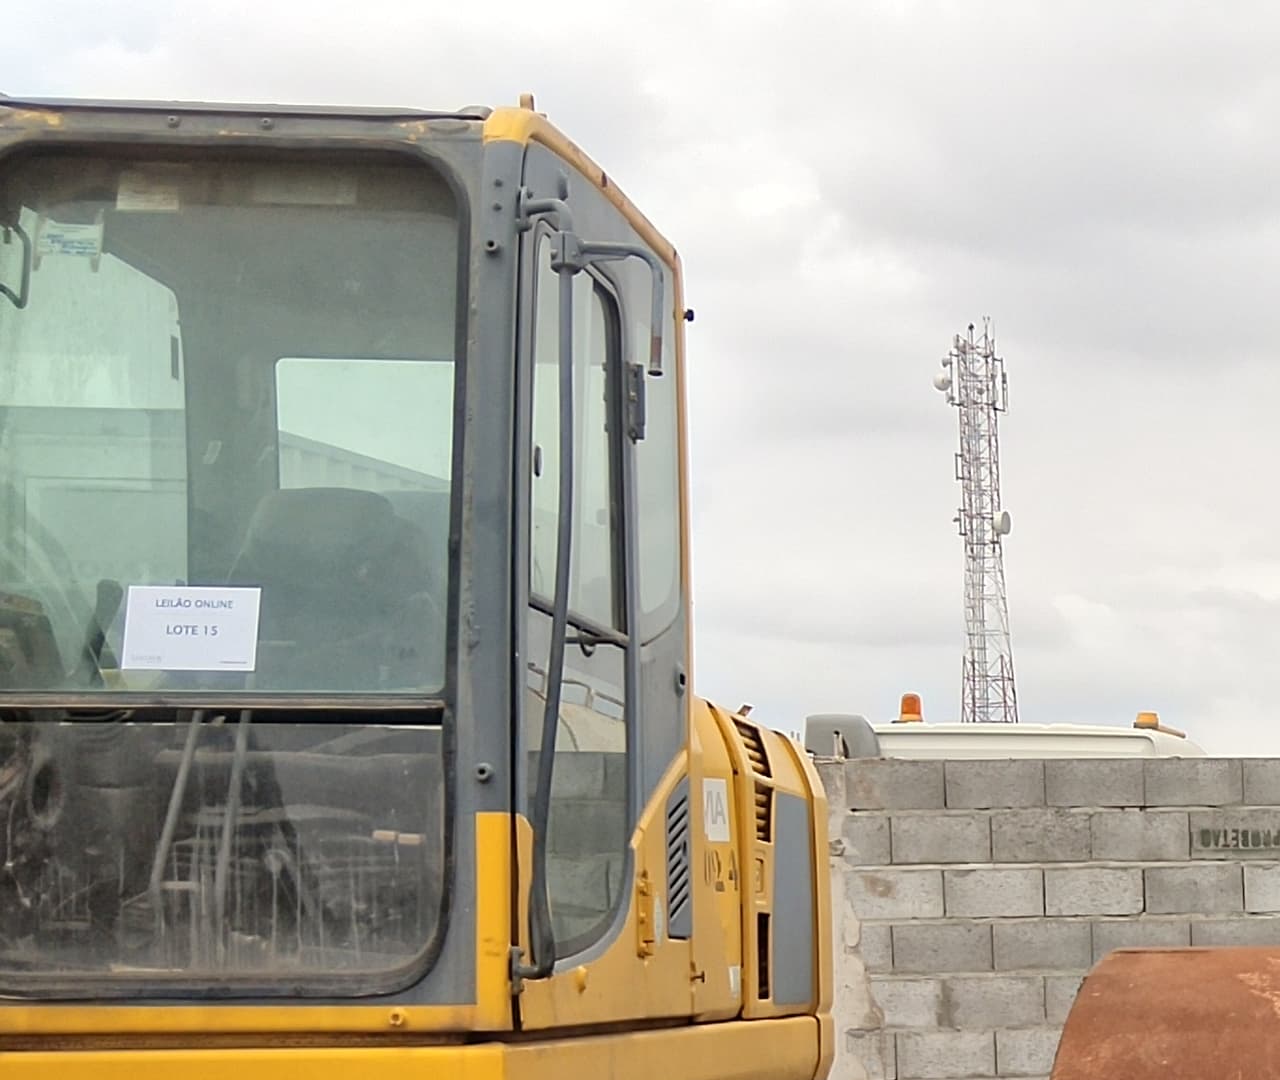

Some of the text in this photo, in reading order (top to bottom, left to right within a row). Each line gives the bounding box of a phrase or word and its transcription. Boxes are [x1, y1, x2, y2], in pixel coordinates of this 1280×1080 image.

[155, 598, 234, 609] LEILÃO ONLINE
[166, 624, 219, 636] LOTE 15
